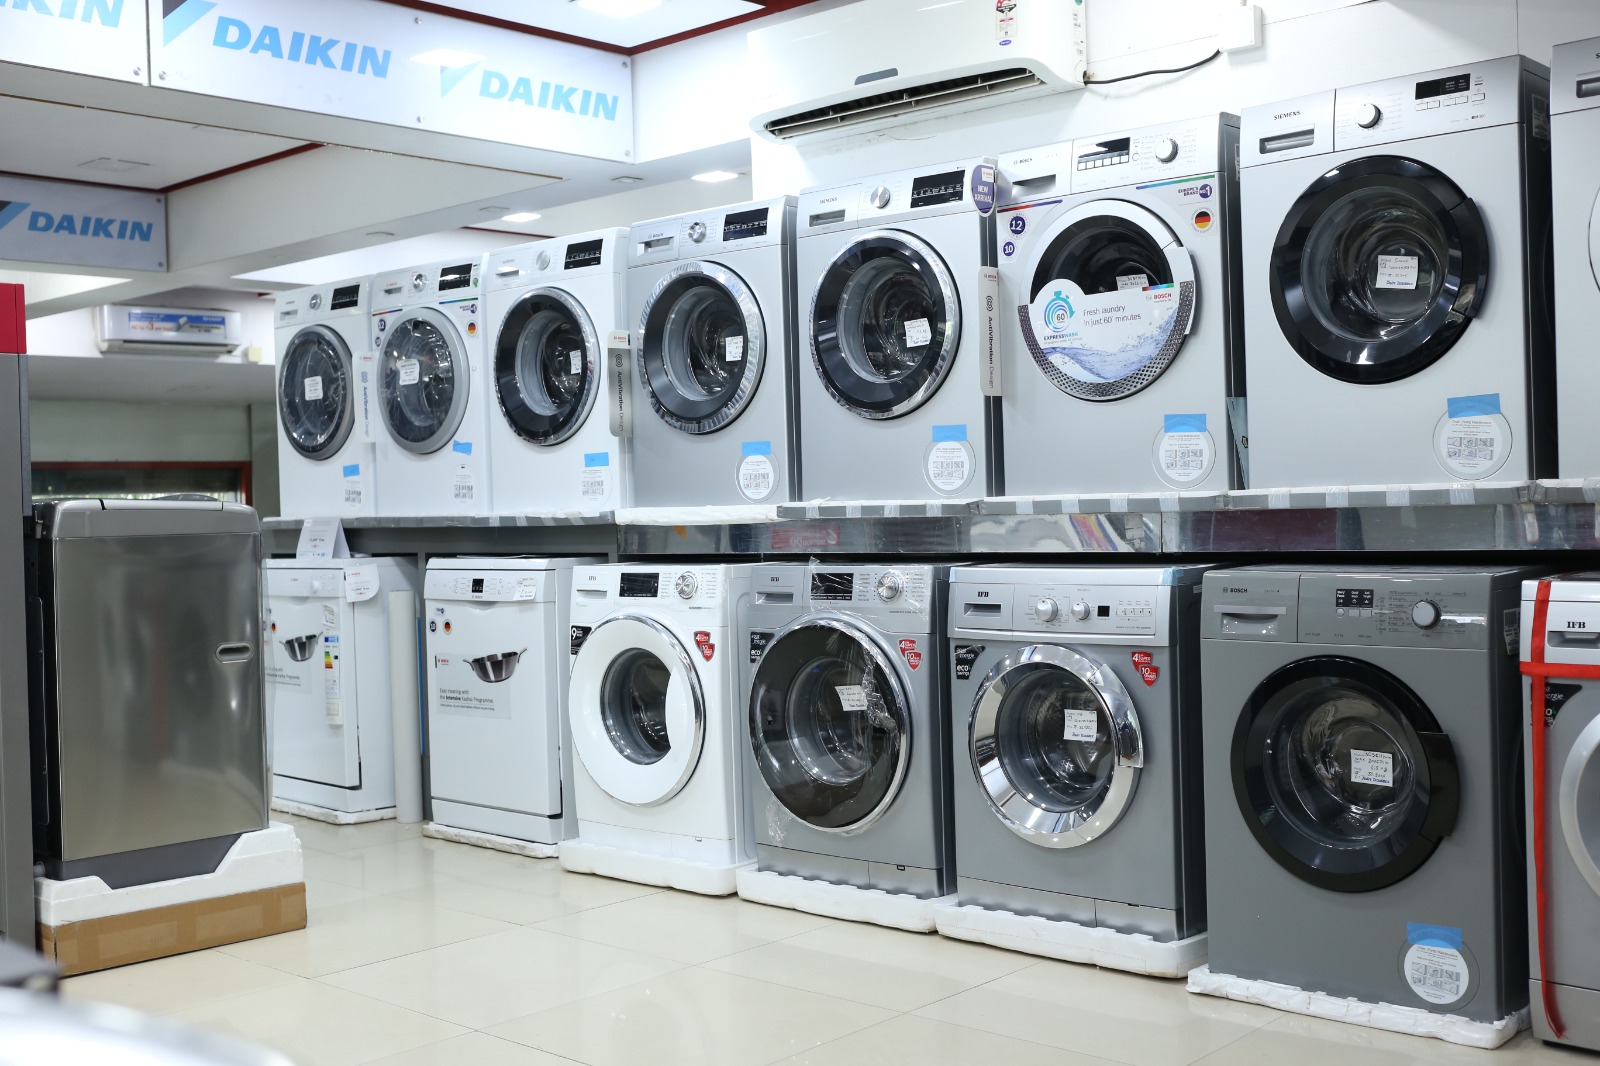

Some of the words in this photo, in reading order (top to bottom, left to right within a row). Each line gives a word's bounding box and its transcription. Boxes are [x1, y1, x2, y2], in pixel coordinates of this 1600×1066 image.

[212, 15, 392, 79] DAIKIN
[480, 70, 619, 122] DAIKIN
[1273, 110, 1301, 121] SIEMENS
[978, 184, 989, 193] NEW
[28, 210, 154, 242] DAIKIN
[1010, 220, 1023, 231] 12
[1004, 244, 1014, 254] 10
[1083, 308, 1100, 317] Fresh
[1101, 305, 1126, 316] laundry
[1090, 316, 1103, 327] just
[1115, 313, 1142, 322] minutes
[1566, 621, 1586, 629] IFB
[572, 627, 577, 640] 9
[1132, 653, 1138, 662] 4
[1142, 667, 1150, 675] 10
